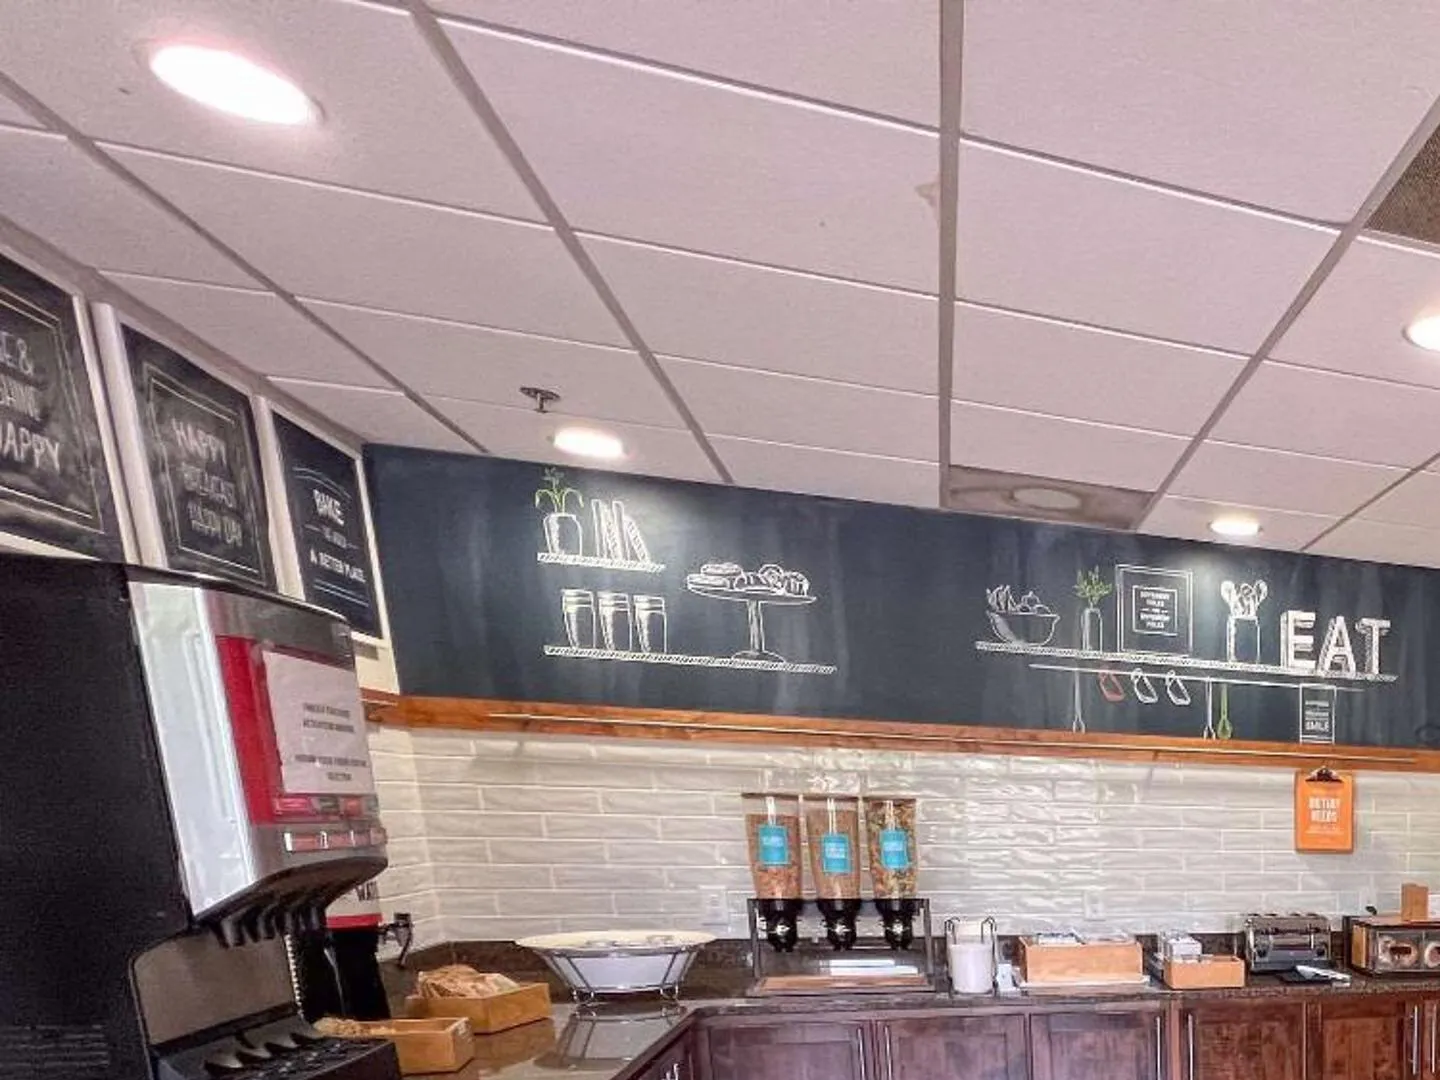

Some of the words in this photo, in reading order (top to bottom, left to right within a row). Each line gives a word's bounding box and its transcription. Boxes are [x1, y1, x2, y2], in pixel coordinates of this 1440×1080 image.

[0, 422, 61, 473] APPY
[171, 417, 228, 466] HAPPY
[1280, 609, 1391, 679] EAT
